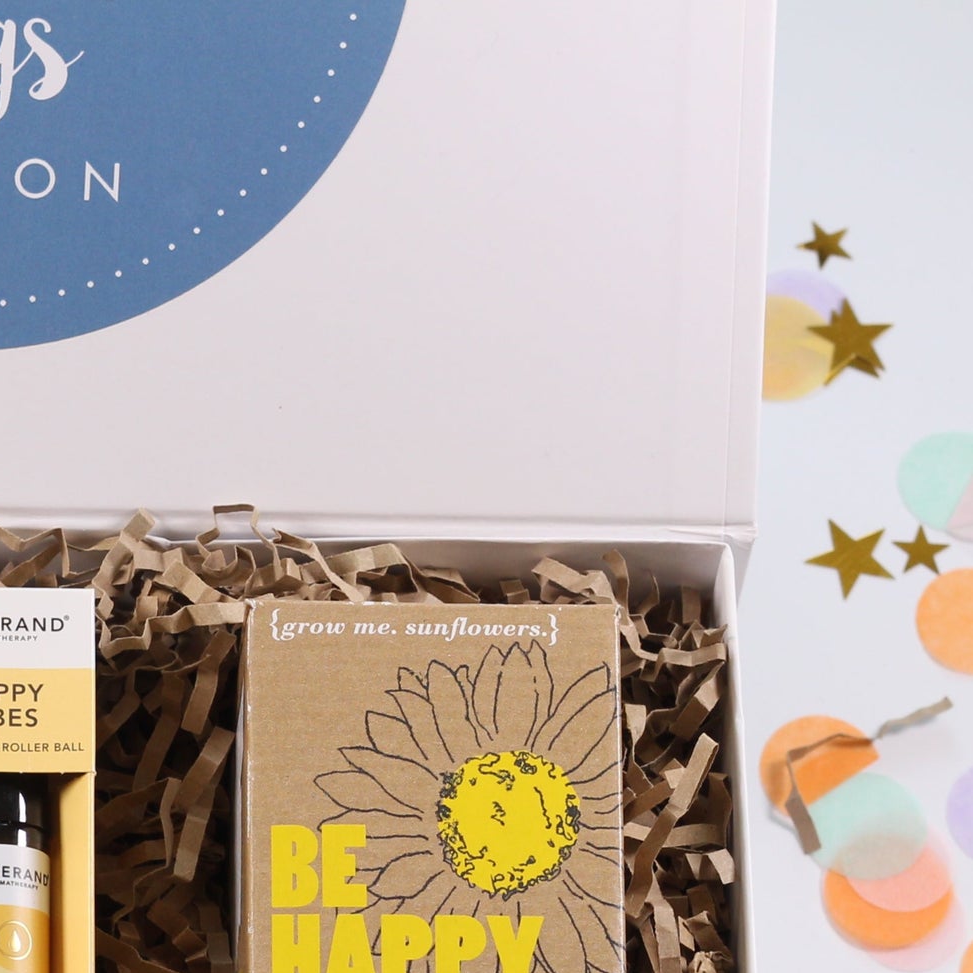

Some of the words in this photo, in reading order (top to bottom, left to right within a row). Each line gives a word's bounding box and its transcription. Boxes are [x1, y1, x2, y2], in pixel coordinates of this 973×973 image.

[353, 620, 397, 636] me.
[2, 742, 49, 752] ROLLER
[54, 742, 85, 752] BALL
[270, 823, 367, 907] BE
